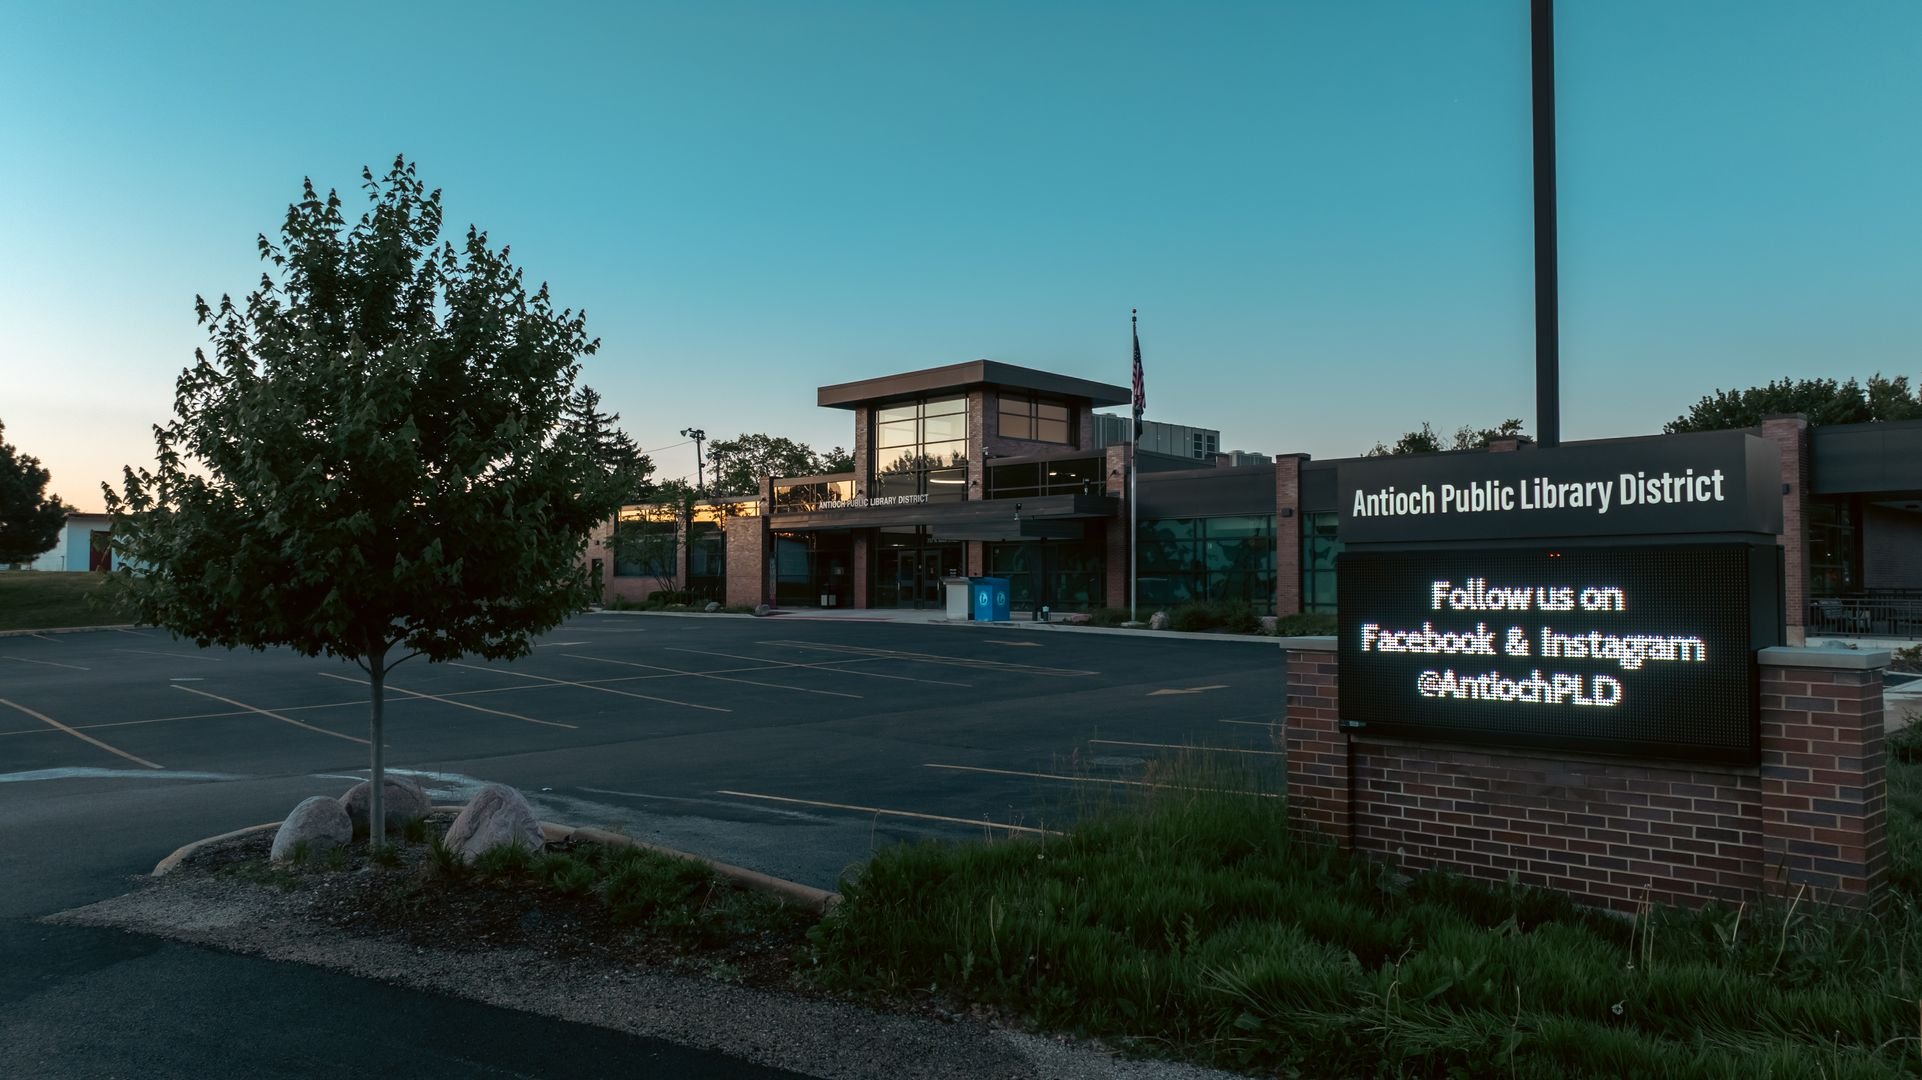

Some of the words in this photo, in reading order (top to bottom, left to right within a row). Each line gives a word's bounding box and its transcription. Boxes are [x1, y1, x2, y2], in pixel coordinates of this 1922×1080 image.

[819, 500, 846, 509] ANTIOCH
[846, 498, 869, 508] PUBLIC
[870, 496, 897, 506] LIBRARY
[898, 493, 929, 504] DISTRICT
[1353, 485, 1435, 517] Antioch
[1441, 480, 1514, 513] Public
[1521, 477, 1613, 513] Library
[1620, 469, 1724, 505] District
[1431, 577, 1533, 610] Follow
[1536, 586, 1575, 611] us
[1580, 586, 1626, 611] on
[1360, 621, 1497, 656] Facebook
[1504, 626, 1531, 656] &
[1541, 626, 1706, 669] Instagram
[1417, 669, 1622, 706] @AntiochPLD
